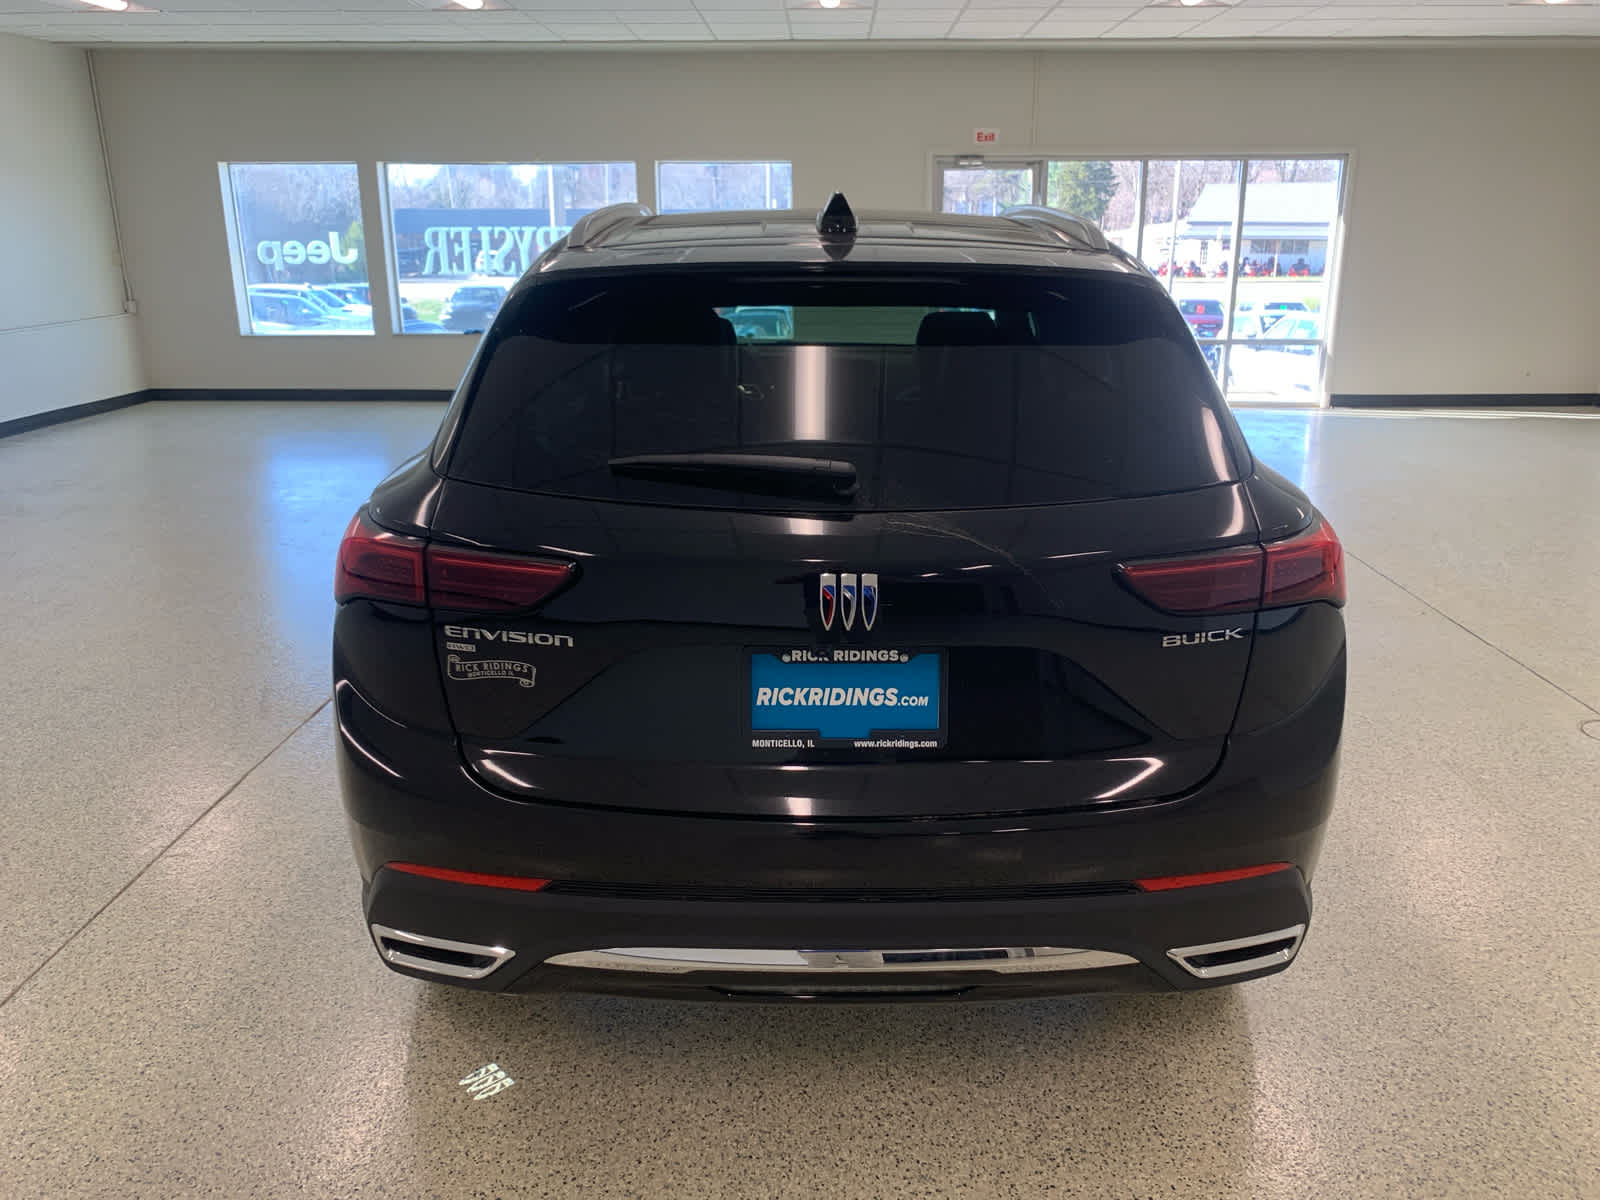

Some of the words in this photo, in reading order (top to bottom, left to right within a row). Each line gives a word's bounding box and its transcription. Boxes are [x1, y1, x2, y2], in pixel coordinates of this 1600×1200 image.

[976, 131, 996, 142] Exit
[1162, 627, 1244, 647] BUICK
[791, 650, 830, 662] RIC
[833, 650, 899, 662] RIDINGS
[482, 662, 528, 673] RIDINGS
[756, 687, 929, 707] RICKRIDINGS.COM
[752, 739, 805, 749] MONTICELLO,
[807, 739, 815, 748] IL
[854, 739, 938, 749] www.rickridings.com
